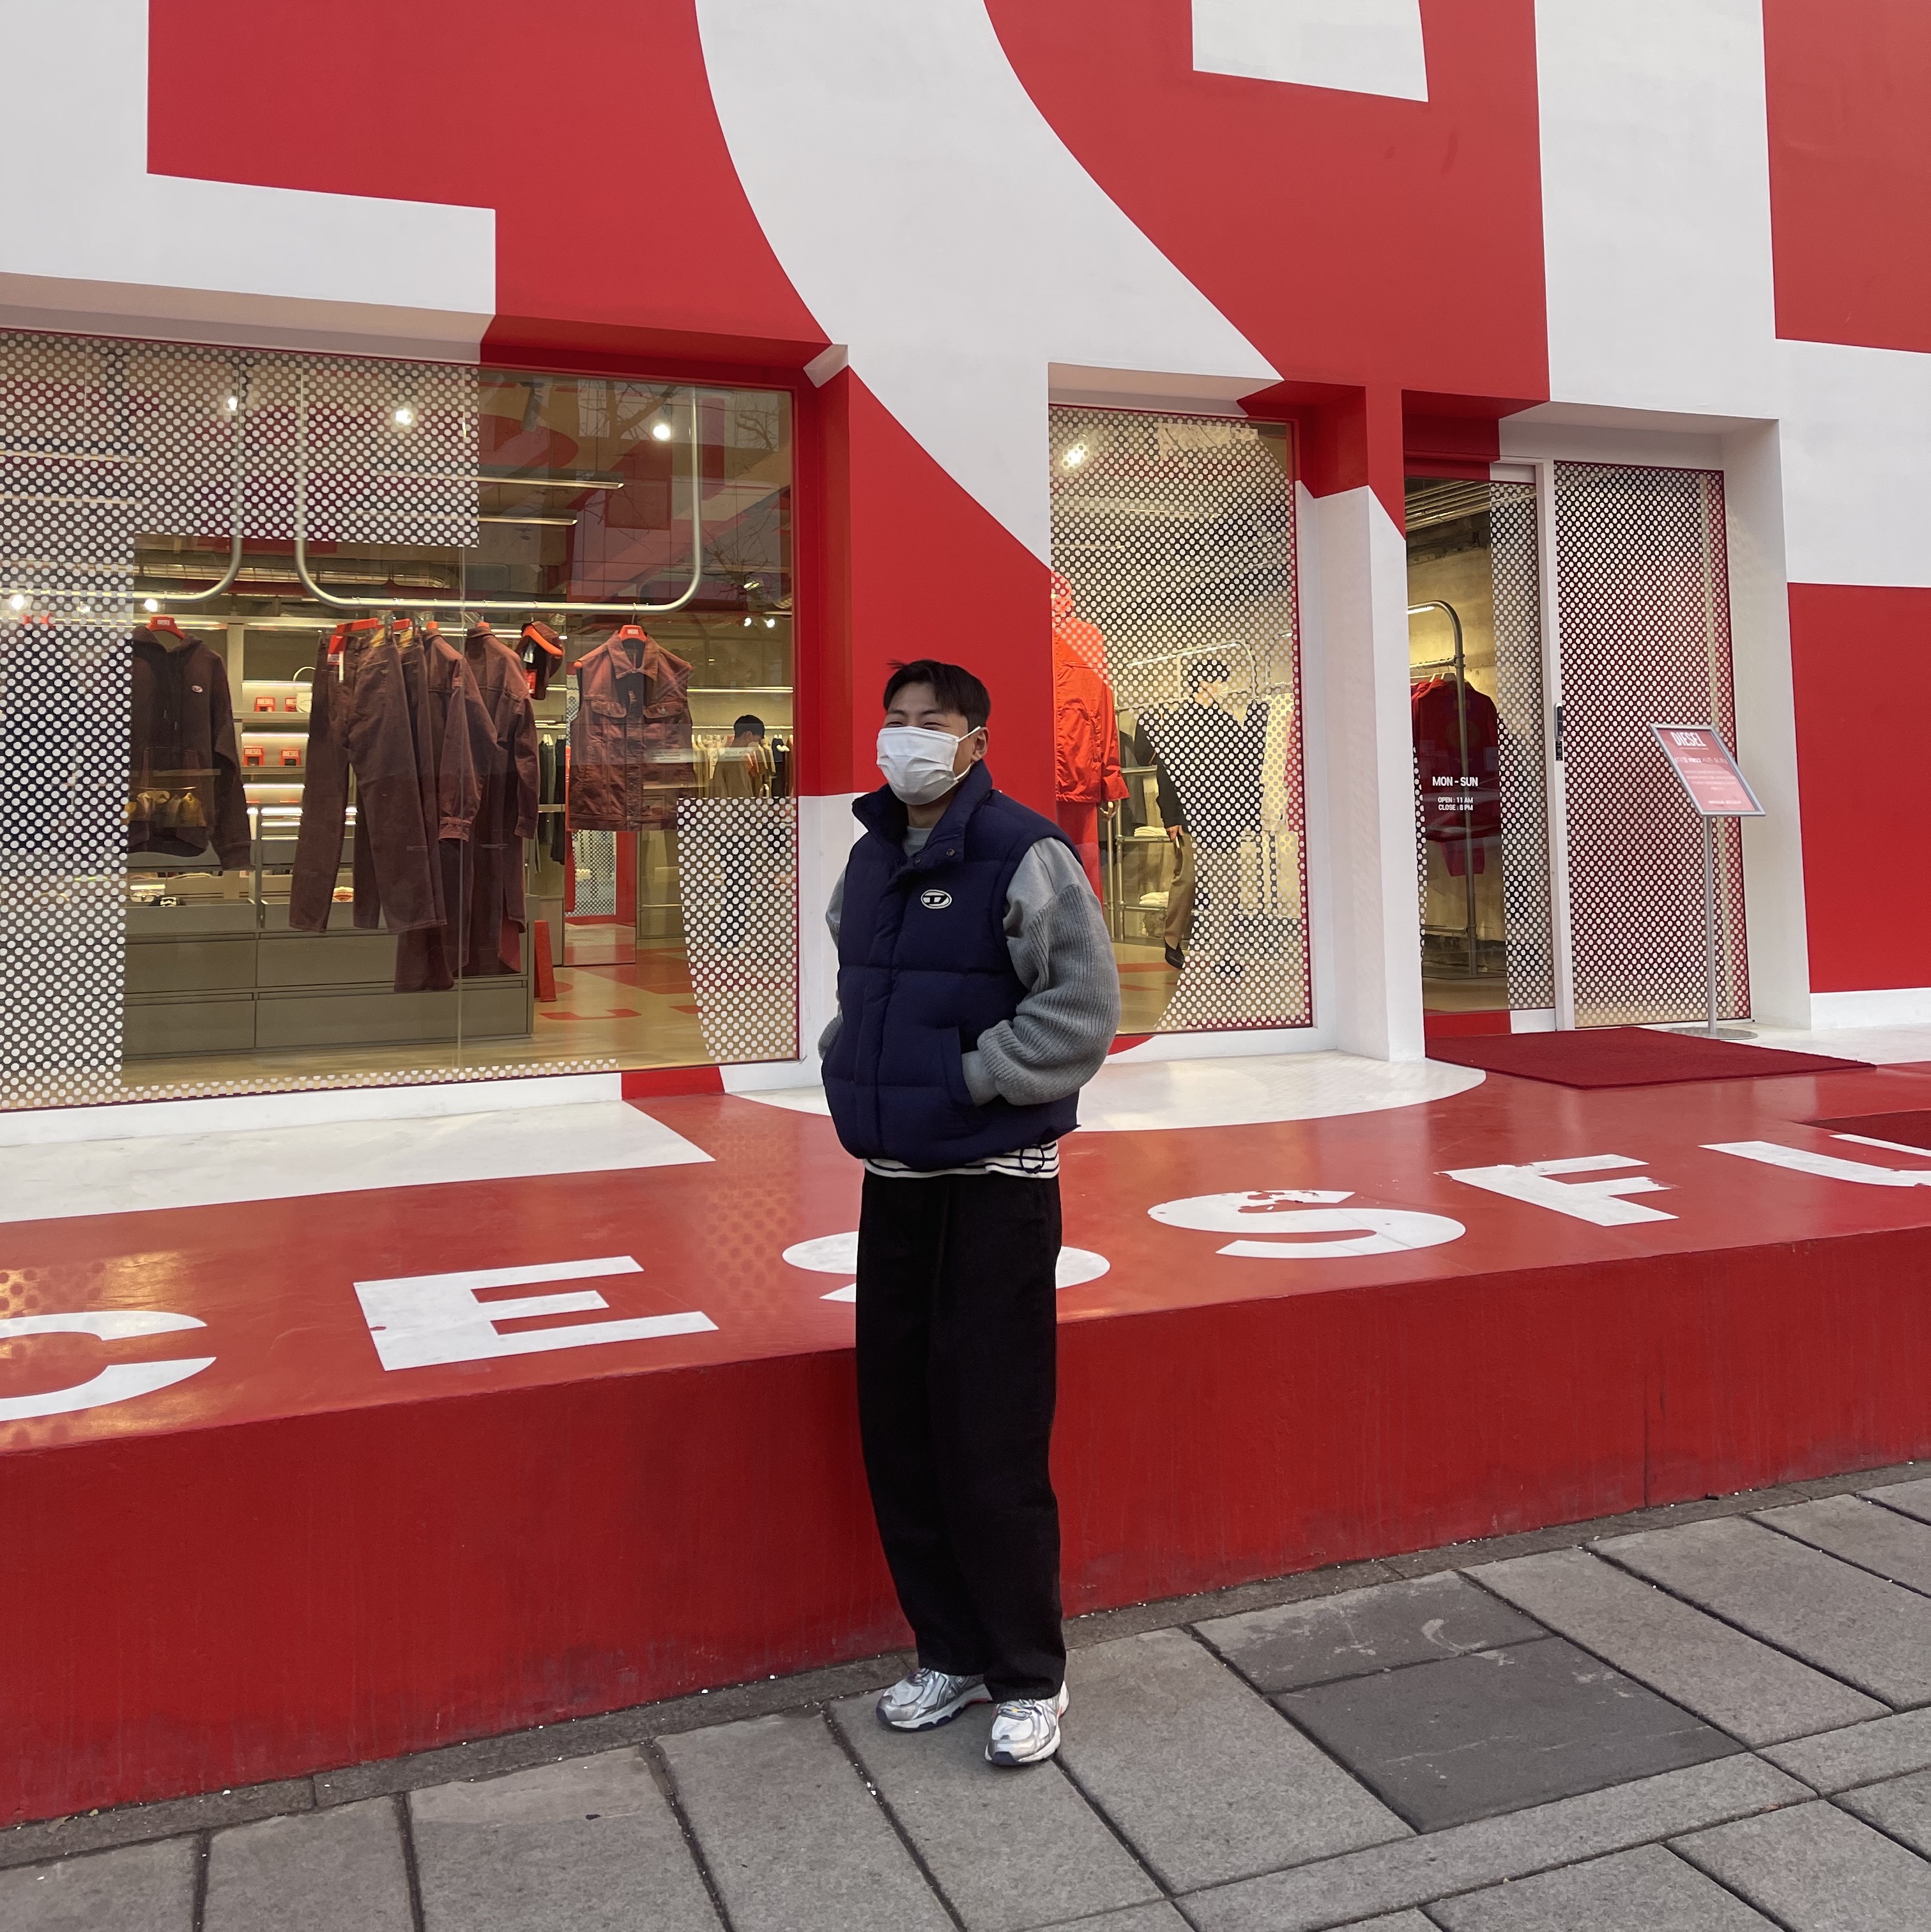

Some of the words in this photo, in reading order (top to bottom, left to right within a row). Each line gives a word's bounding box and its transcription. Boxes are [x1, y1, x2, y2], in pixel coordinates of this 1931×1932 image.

[1670, 732, 1707, 747] DIESEL
[1432, 776, 1453, 786] MON
[1460, 776, 1479, 786] SUN
